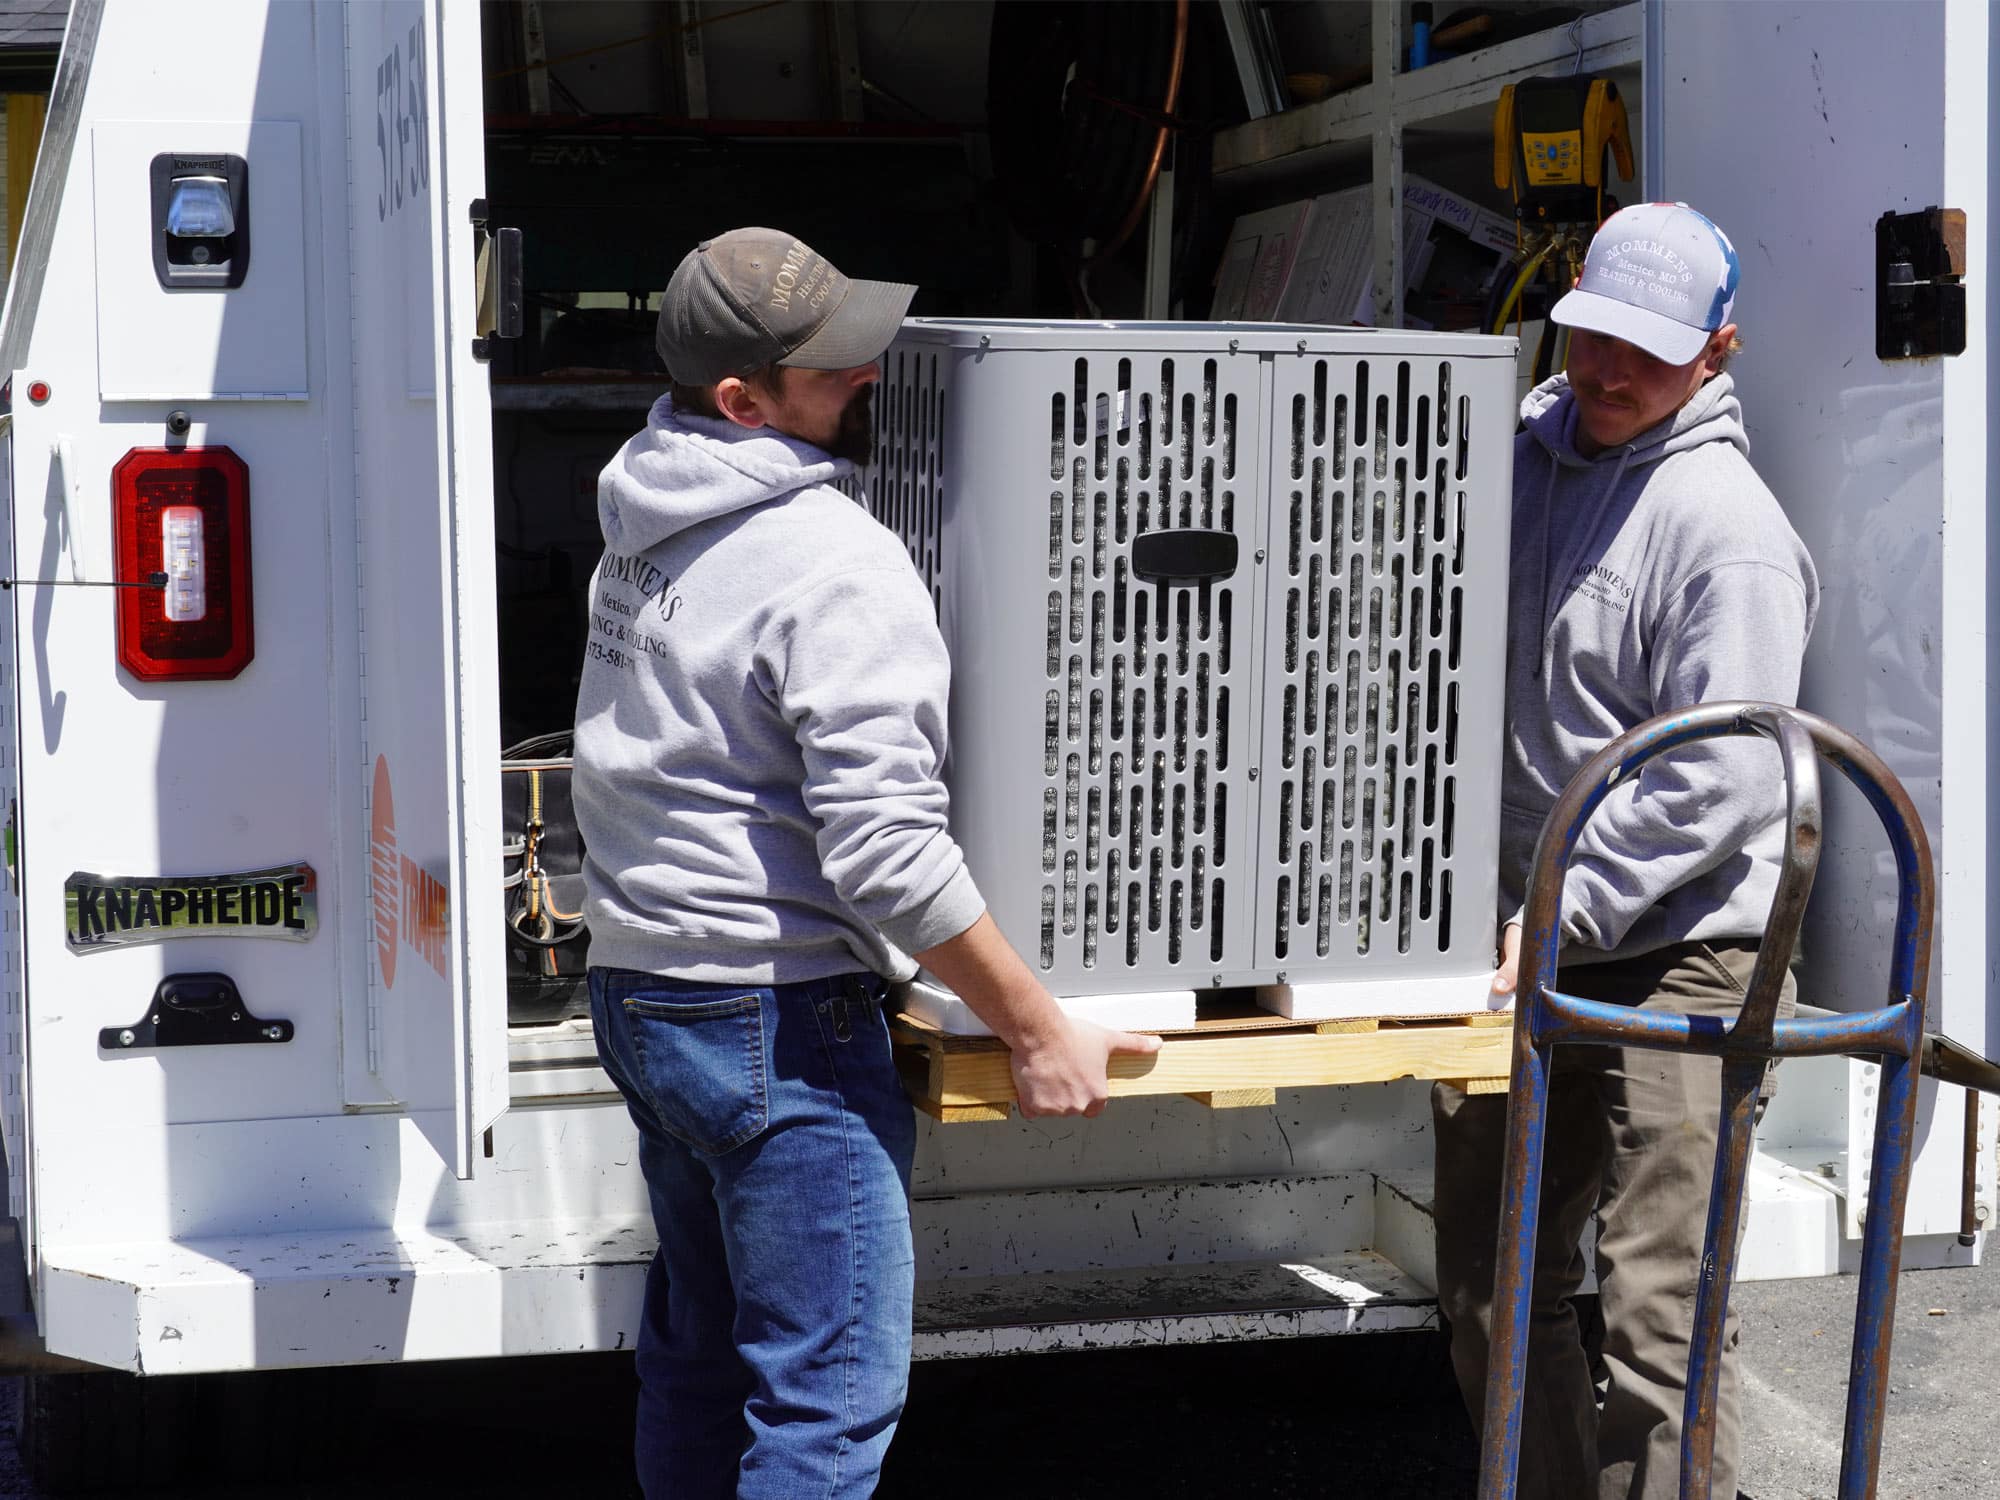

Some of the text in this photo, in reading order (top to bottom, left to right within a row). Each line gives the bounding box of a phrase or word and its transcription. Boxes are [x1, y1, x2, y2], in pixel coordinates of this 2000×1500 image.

[174, 159, 225, 171] KNAPHEIDE
[1606, 240, 1693, 282] MOMMENS
[1658, 271, 1677, 284] MO
[1637, 278, 1647, 288] &
[1649, 282, 1689, 303] COOLING
[1597, 595, 1625, 612] COOLING
[616, 625, 626, 641] &
[77, 874, 306, 942] KNAPHEIDE
[400, 852, 447, 982] TRANE
